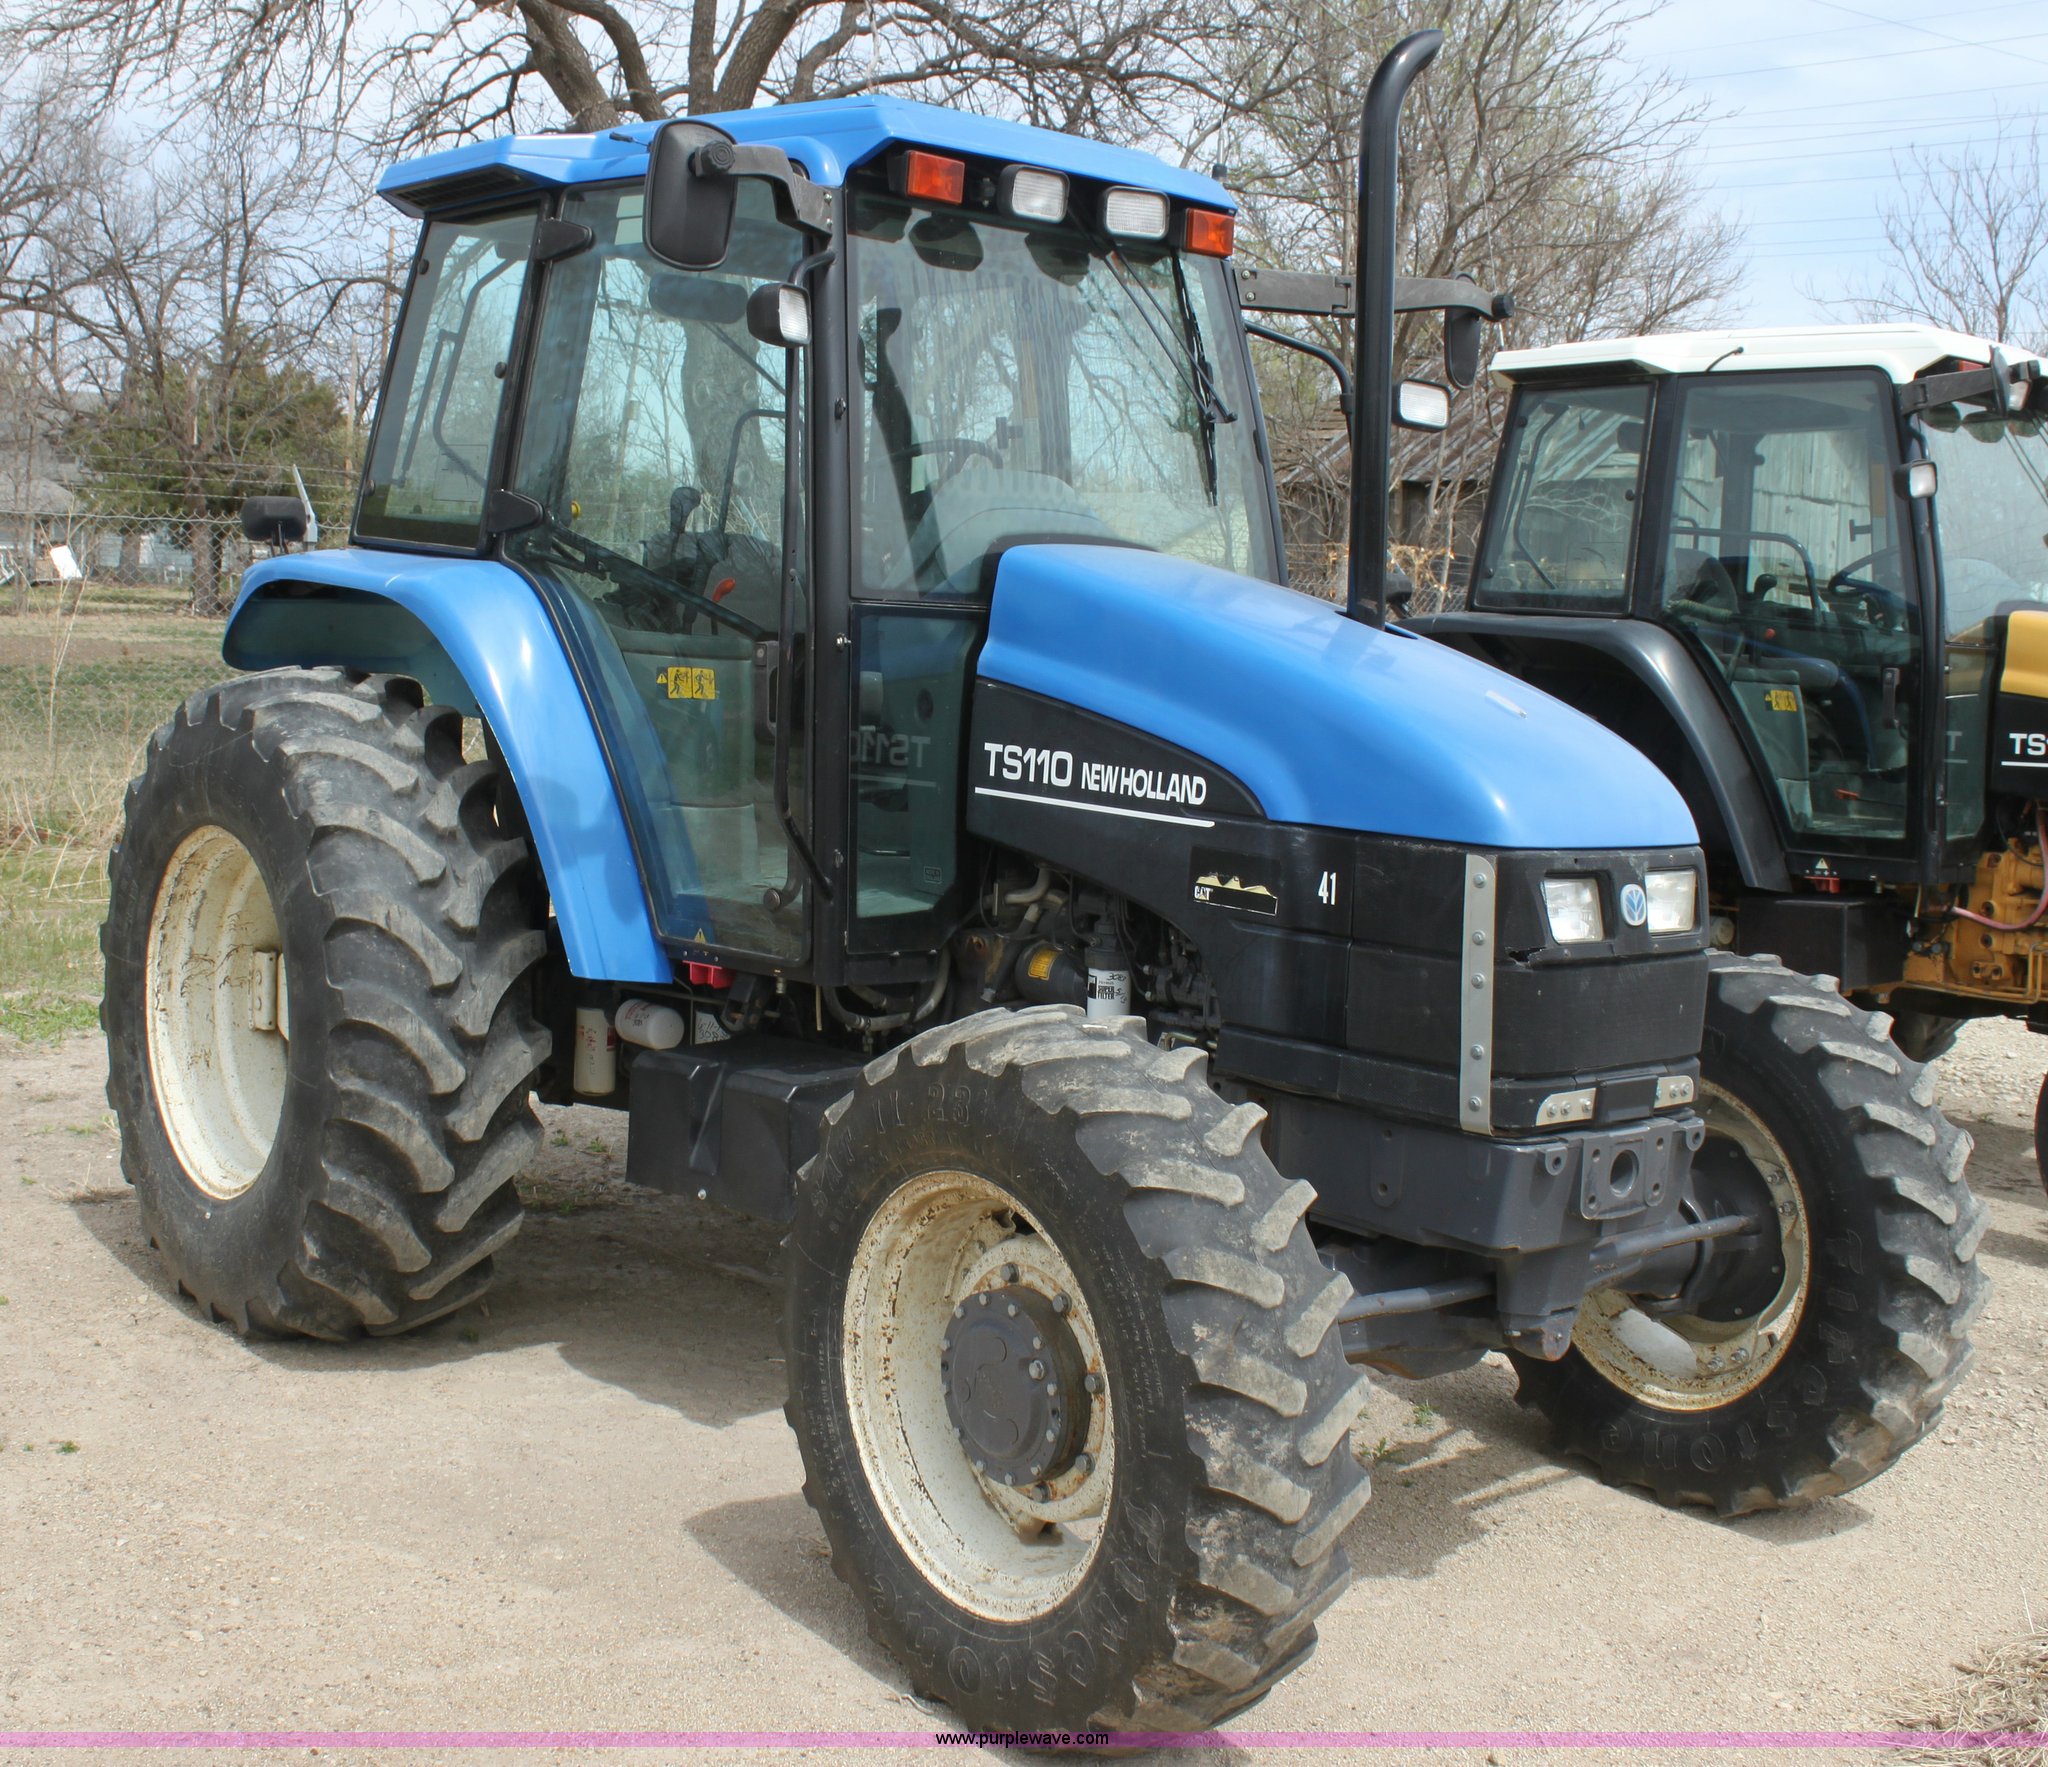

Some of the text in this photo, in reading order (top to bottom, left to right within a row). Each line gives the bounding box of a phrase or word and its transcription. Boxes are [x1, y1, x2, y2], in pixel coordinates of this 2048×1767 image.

[2009, 733, 2048, 756] TS
[984, 742, 1073, 788] TS110
[1194, 885, 1211, 901] CAT
[1317, 871, 1337, 906] 41
[865, 1498, 1167, 1706] Firestone
